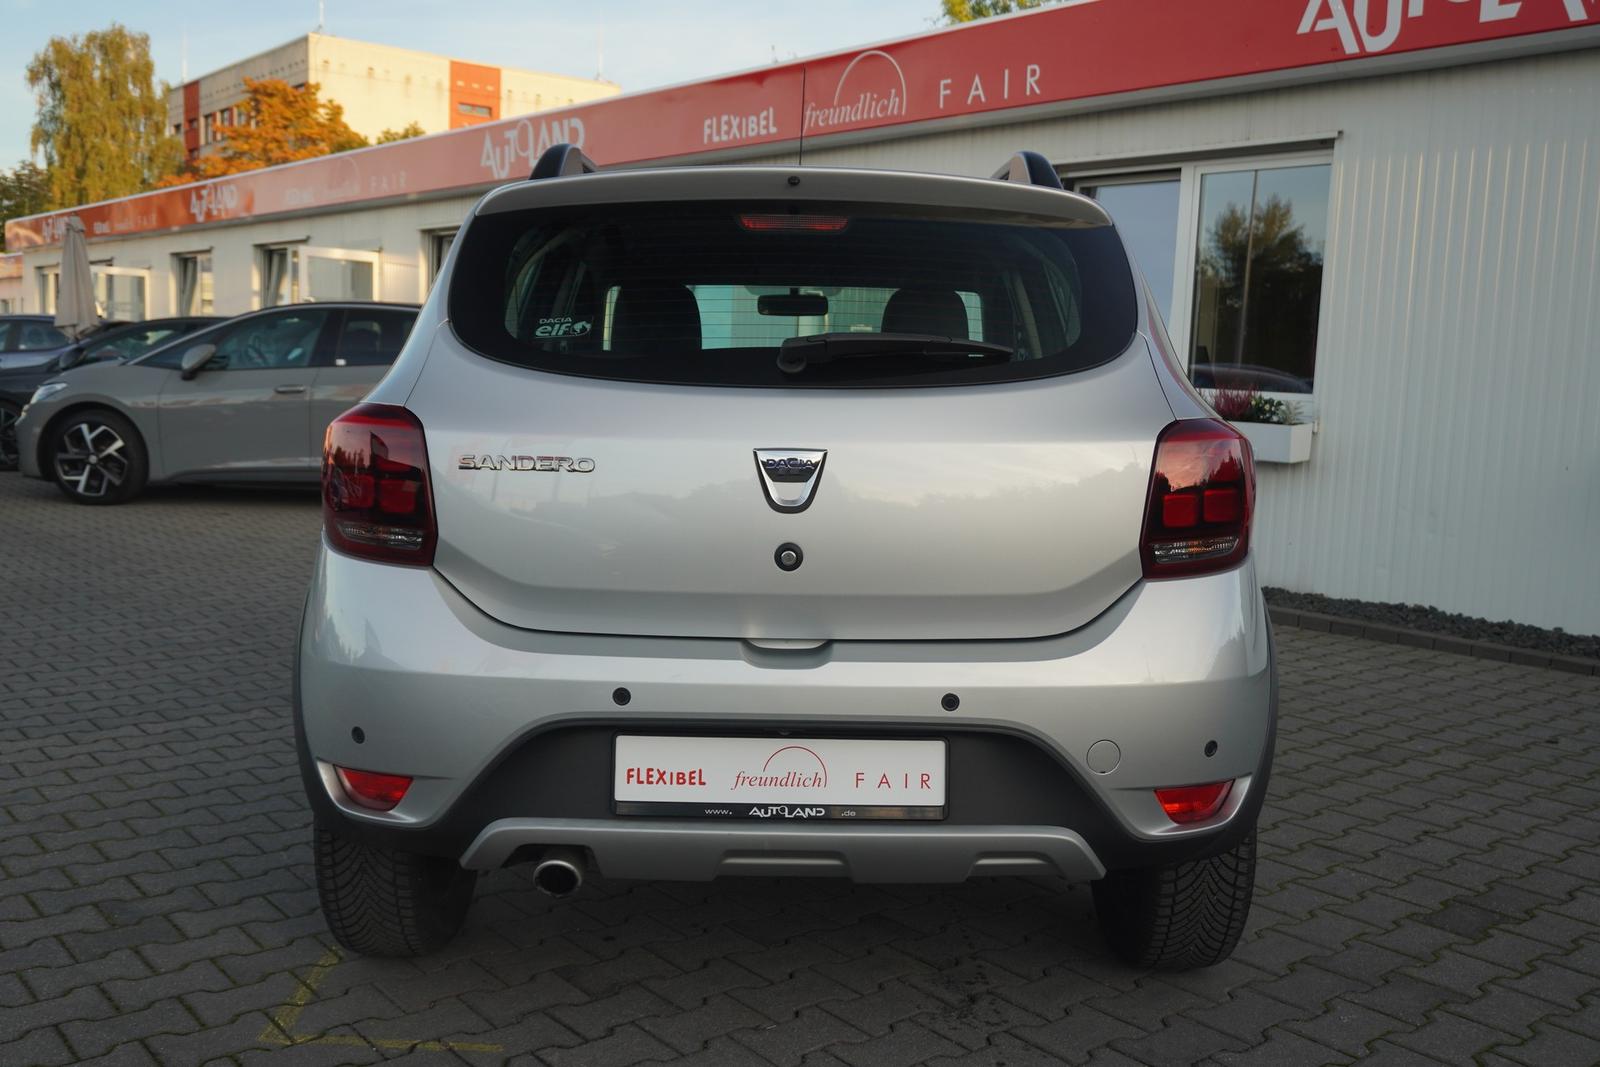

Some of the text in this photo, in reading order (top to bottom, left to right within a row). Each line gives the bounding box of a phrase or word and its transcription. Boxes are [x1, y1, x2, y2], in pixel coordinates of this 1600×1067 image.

[703, 64, 1041, 144] FLEXIBEL freundlich FAIR
[535, 323, 571, 337] elf
[457, 454, 596, 473] SANDERO
[766, 458, 814, 469] DACIA
[626, 767, 931, 790] FLEXIBEL freundlich FAIR
[749, 805, 825, 818] AUTOLAND
